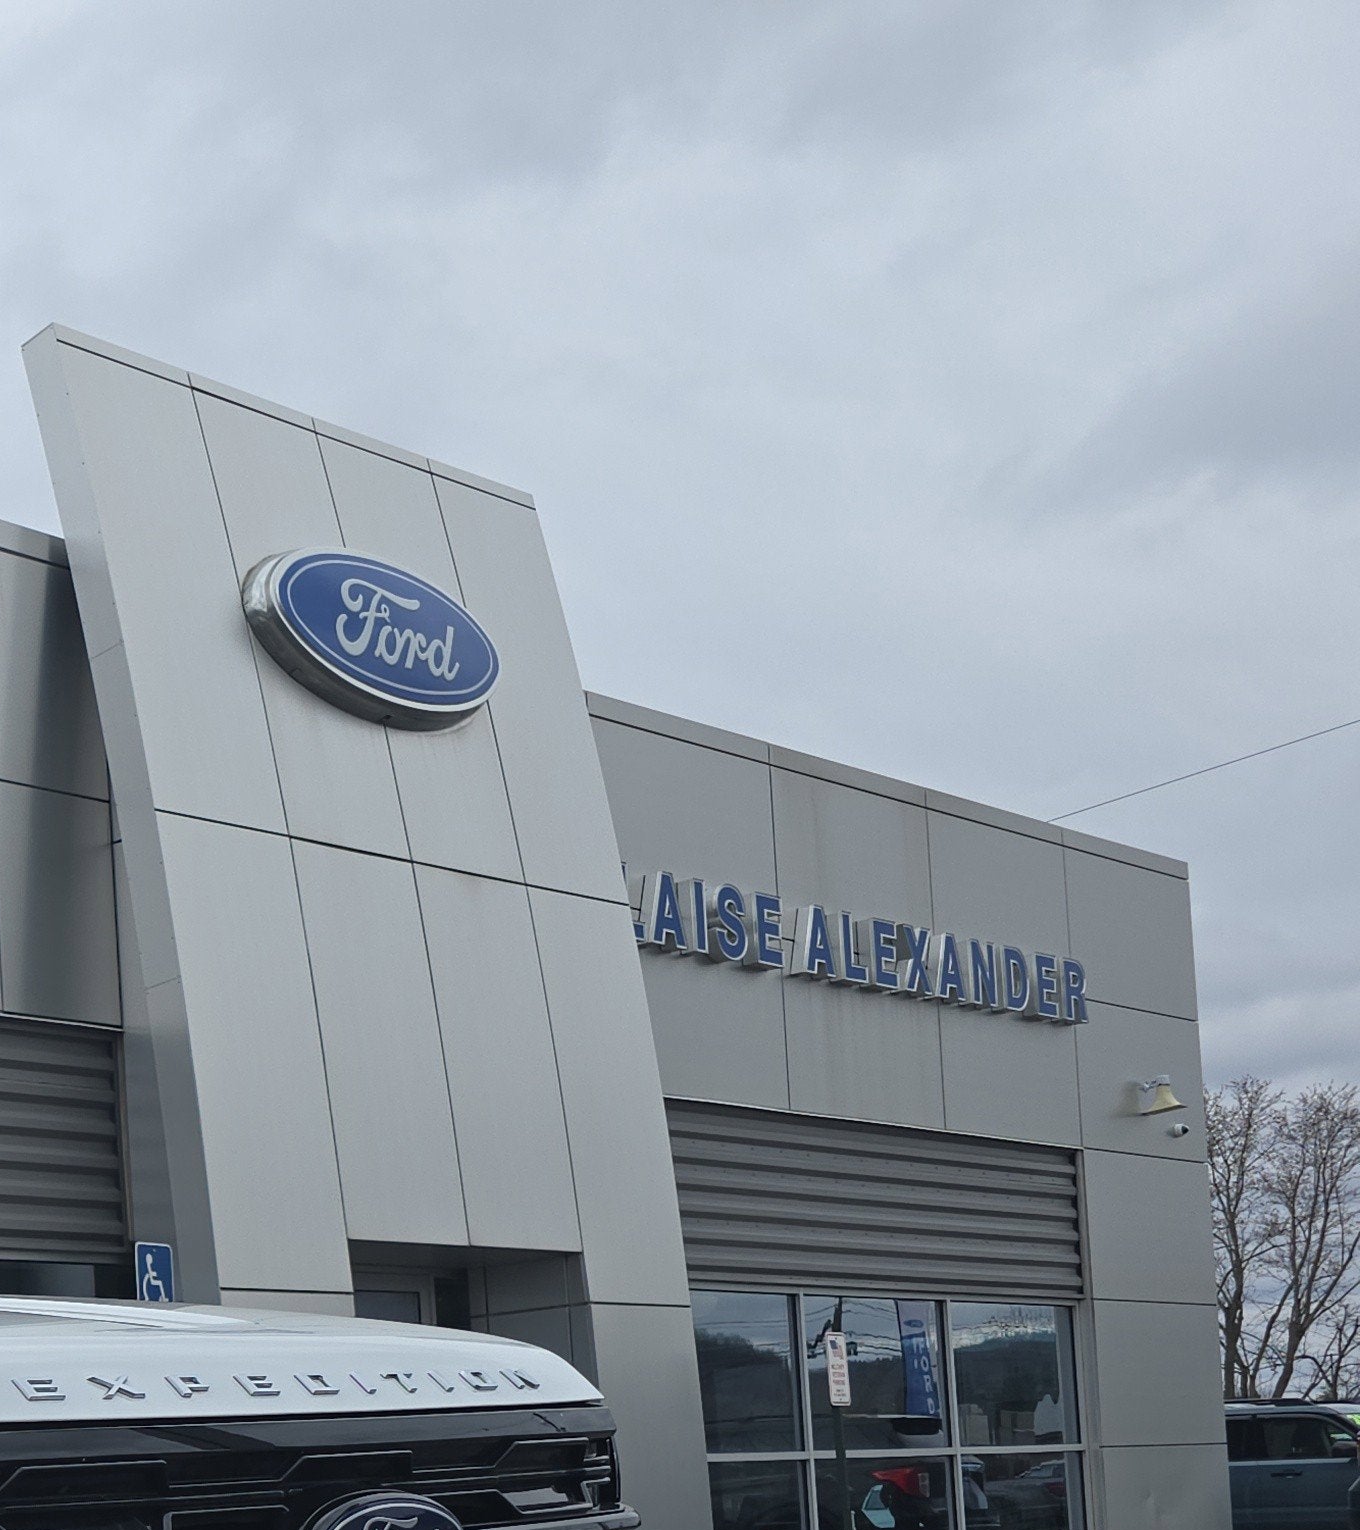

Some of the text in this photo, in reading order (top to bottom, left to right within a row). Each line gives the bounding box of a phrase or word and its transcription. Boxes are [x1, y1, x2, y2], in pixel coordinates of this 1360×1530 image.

[335, 578, 461, 681] Ford
[621, 862, 1088, 1024] AISE ALEXANDER
[11, 1369, 541, 1401] EXPEDITION
